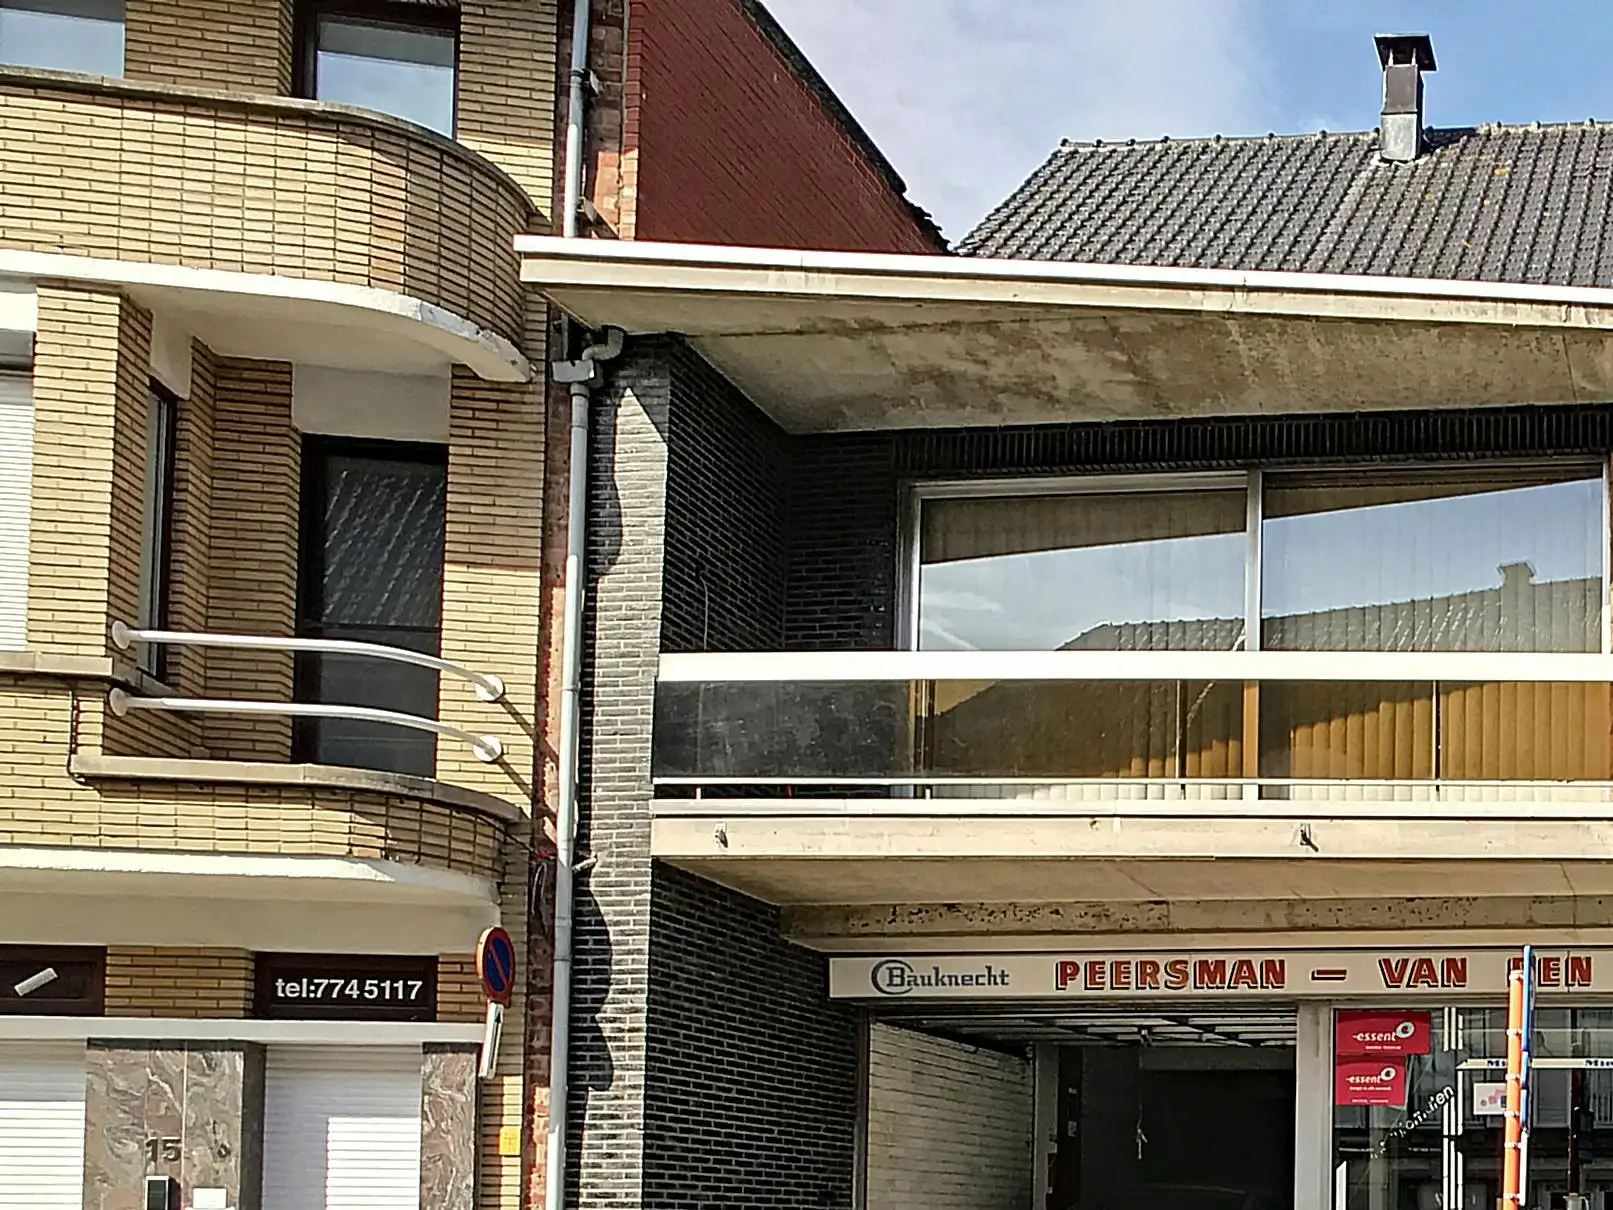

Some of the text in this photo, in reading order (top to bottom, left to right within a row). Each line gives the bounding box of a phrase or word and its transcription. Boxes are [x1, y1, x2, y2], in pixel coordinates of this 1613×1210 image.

[872, 960, 1010, 994] Bauknecht
[1055, 958, 1286, 991] PEERSMAN
[1378, 956, 1467, 989] VAN
[145, 1136, 182, 1163] 15
